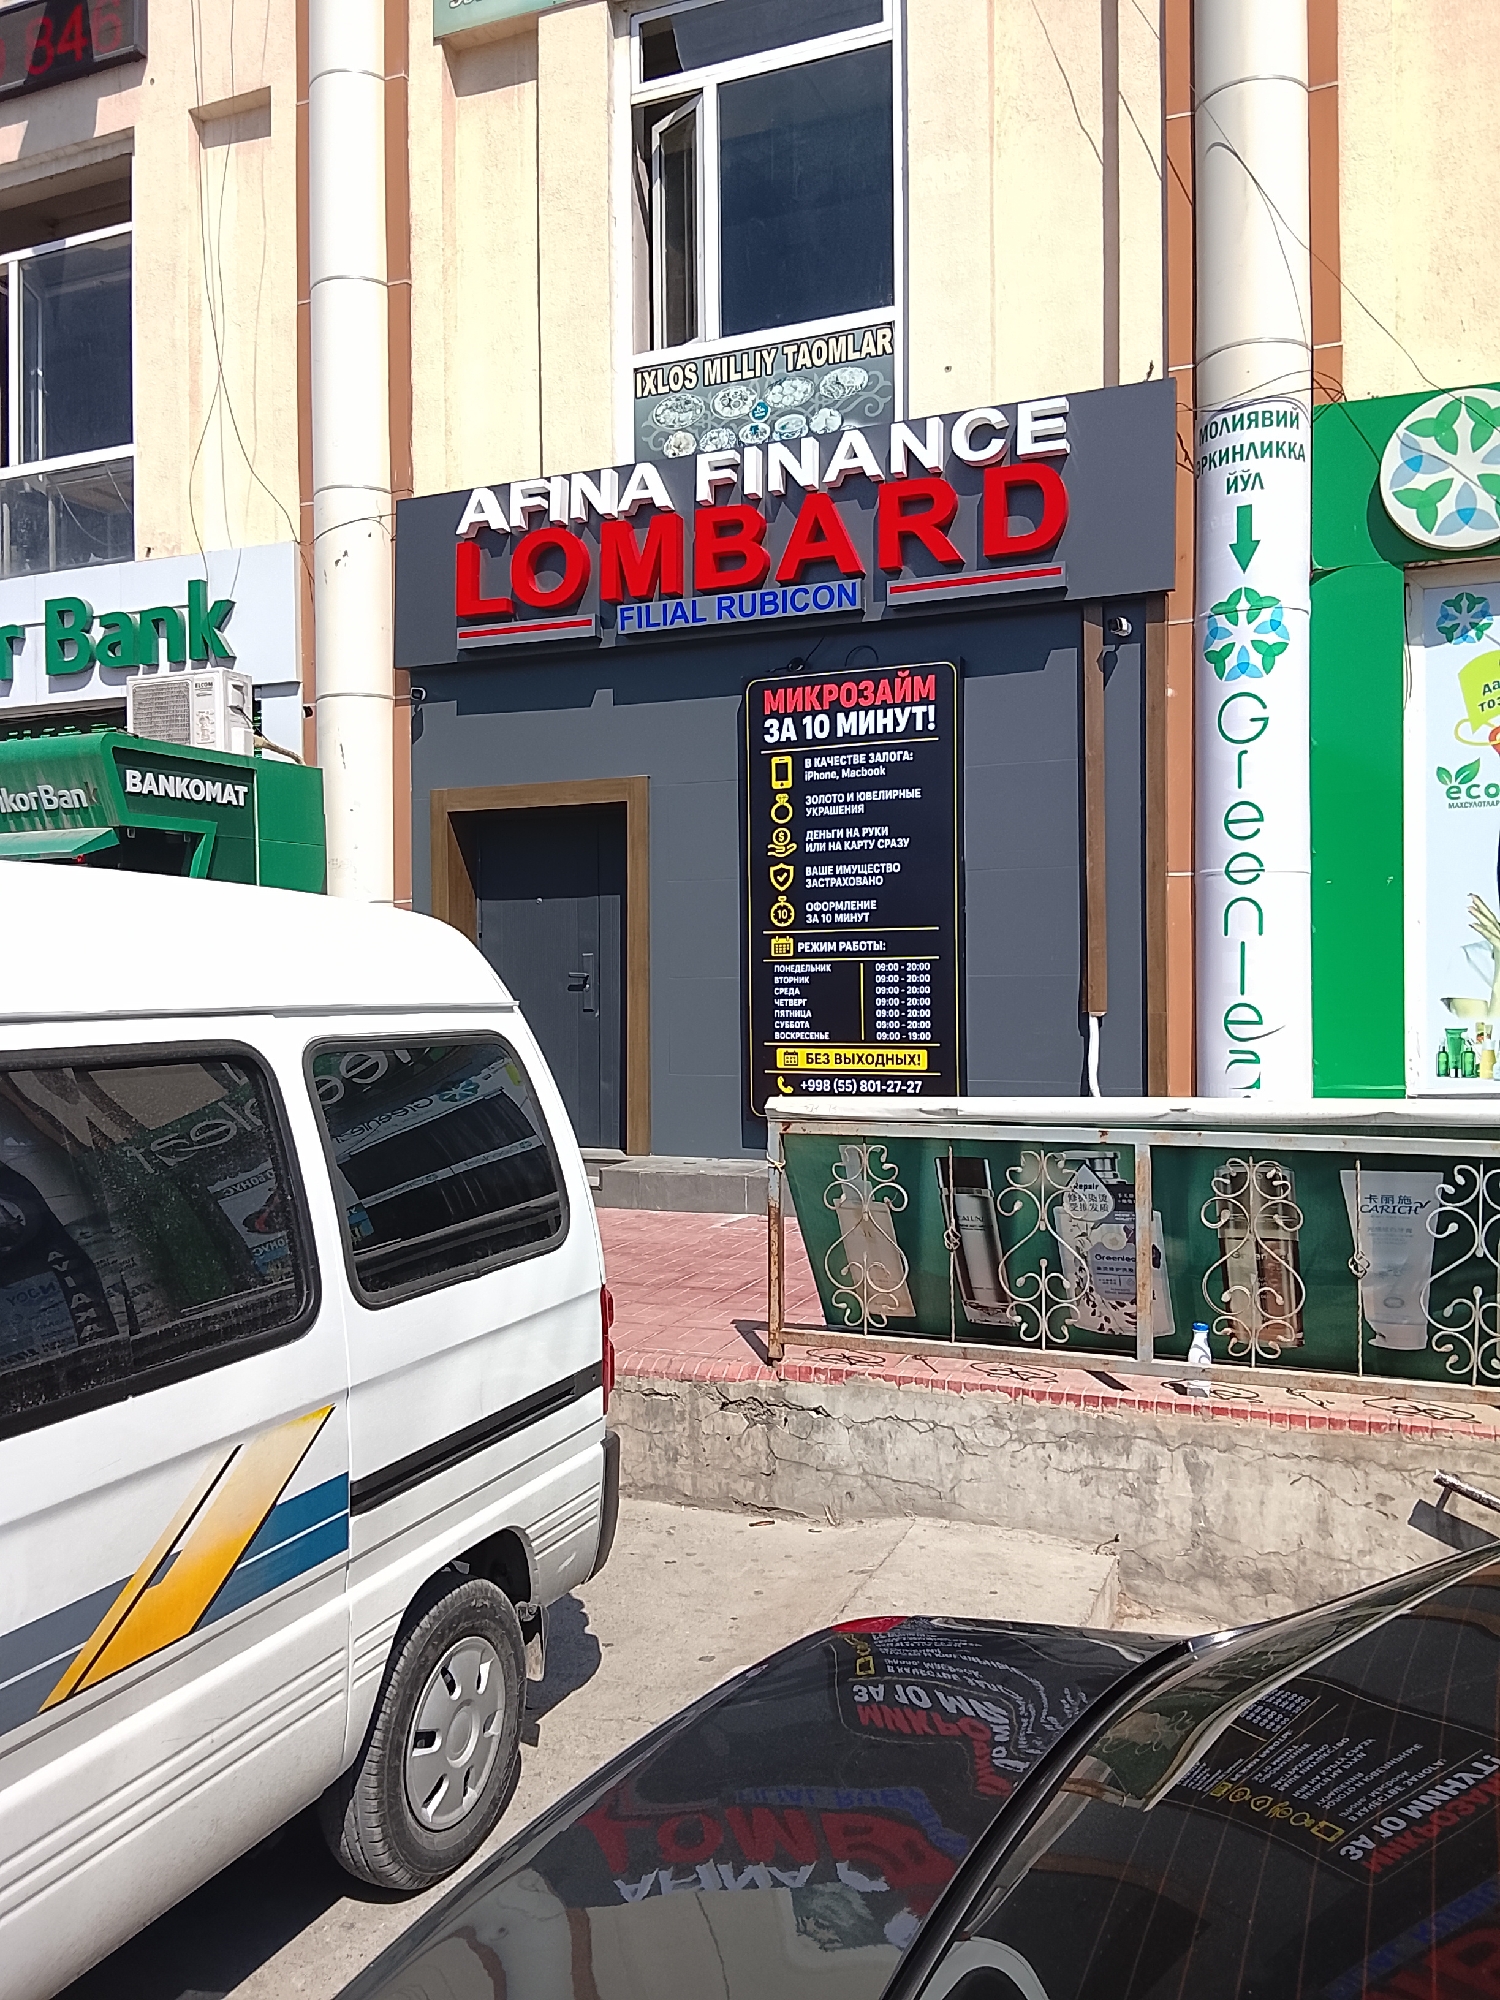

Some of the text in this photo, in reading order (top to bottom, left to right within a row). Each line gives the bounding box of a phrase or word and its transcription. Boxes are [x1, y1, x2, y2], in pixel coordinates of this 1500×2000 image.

[25, 0, 122, 75] 846
[634, 327, 894, 398] IXLOS MILLIY TAOMLAR
[1199, 406, 1299, 447] МОЛИЯВИЙ
[456, 397, 1070, 538] AFINA FINANCE
[1226, 468, 1265, 495] ЙЎЛ
[455, 462, 1069, 619] LOMBARD
[619, 581, 859, 632] FILIAL RUBICON
[45, 579, 236, 675] Bank
[764, 669, 936, 715] МИКРОЗАЙМ
[763, 704, 936, 743] ЗА 10 МИНУТ!
[805, 751, 914, 768] В КАЧЕСТВЕ ЗАЛОГА:
[805, 765, 886, 781] iPhone, Macbook
[125, 769, 249, 807] BANKOMAT
[805, 788, 922, 805] ЗОЛОТО И ЮВЕЛИРНЫЕ
[805, 804, 865, 817] УКРАШЕНИЯ
[805, 826, 889, 841] ДЕНЬГИ НА РУКИ
[805, 838, 910, 852] ИЛИ НА КАРТУ СРАЗУ
[805, 862, 901, 876] ВАШЕ ИМУЩЕСТВО
[805, 875, 883, 888] ЗАСТРАХОВАНО
[1217, 691, 1270, 1098] Greenlea
[805, 900, 877, 912] ОФОРМЛЕНИЕ
[805, 912, 870, 924] ЗА 10 МИНУТ
[797, 941, 887, 953] РЕЖИМ РАБОТЫ:
[774, 964, 832, 974] ПОНЕДЕЛЬНИК
[876, 963, 899, 972] 09:00
[906, 963, 930, 971] 20:00
[774, 976, 810, 984] ВТОРНИК
[876, 974, 899, 983] 09:00
[906, 974, 930, 983] 20:00
[774, 987, 800, 996] СРЕДА
[876, 986, 899, 995] 09:00
[906, 986, 930, 995] 20:00
[774, 998, 808, 1007] ЧЕТВЕРГ
[876, 998, 899, 1006] 09:00
[906, 998, 930, 1006] 20:00
[774, 1009, 812, 1019] ПЯТНИЦА
[876, 1010, 899, 1018] 09:00
[906, 1009, 930, 1018] 20:00
[774, 1021, 810, 1029] СУББОТА
[906, 1021, 930, 1029] 20:00
[774, 1031, 830, 1040] ВОСКРЕСЕНЬЕ
[876, 1032, 900, 1040] 09:00
[908, 1032, 931, 1040] 19:00
[805, 1053, 921, 1067] БЕЗ ВЫХОДНЫХ!
[800, 1079, 923, 1094] +998 (55) 801-27-27
[1360, 1201, 1427, 1215] CARICH
[1095, 1253, 1136, 1263] Greenlea
